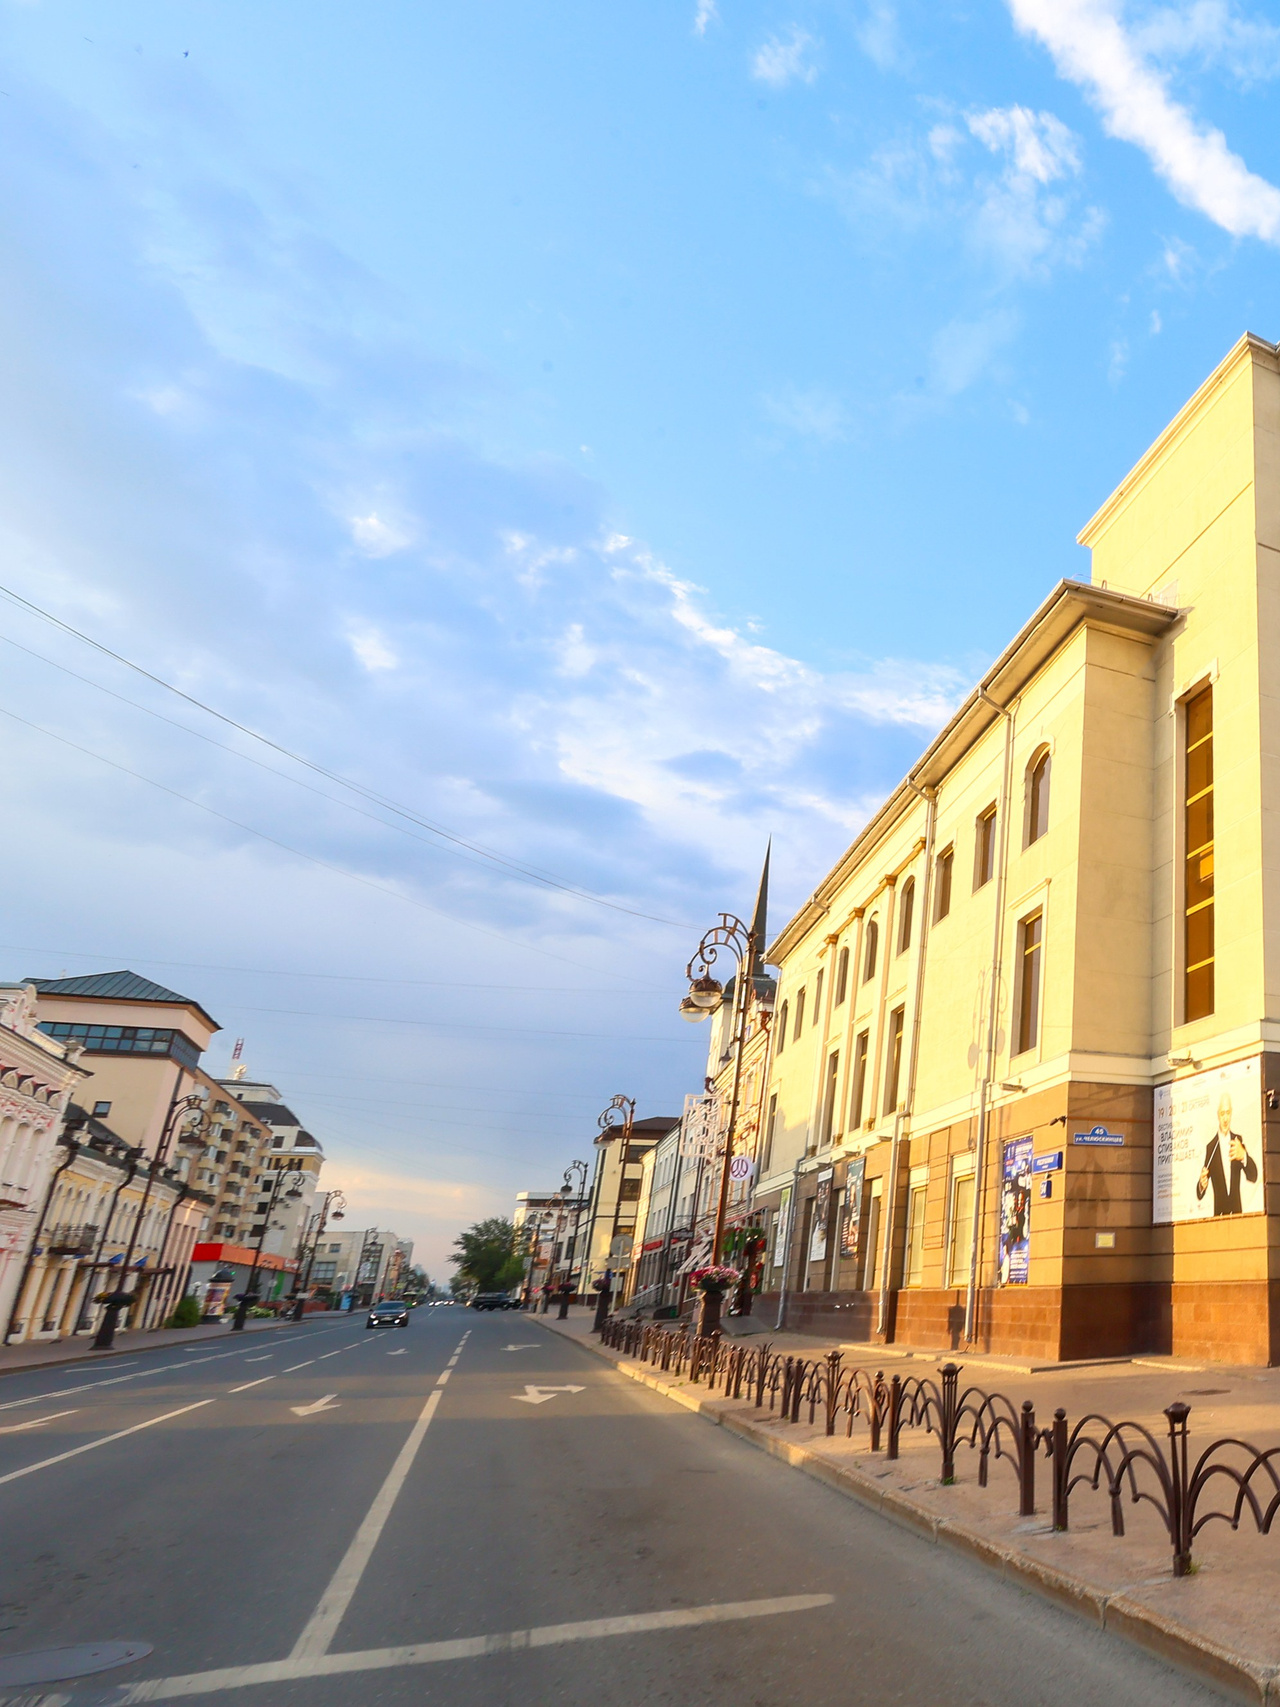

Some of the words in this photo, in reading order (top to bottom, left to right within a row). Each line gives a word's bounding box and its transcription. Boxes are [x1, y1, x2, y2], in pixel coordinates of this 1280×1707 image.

[1158, 1107, 1164, 1119] 19
[1168, 1104, 1176, 1117] 20
[1161, 1126, 1193, 1142] ВЛАДИМИР
[1158, 1139, 1188, 1154] СПИВАКОВ
